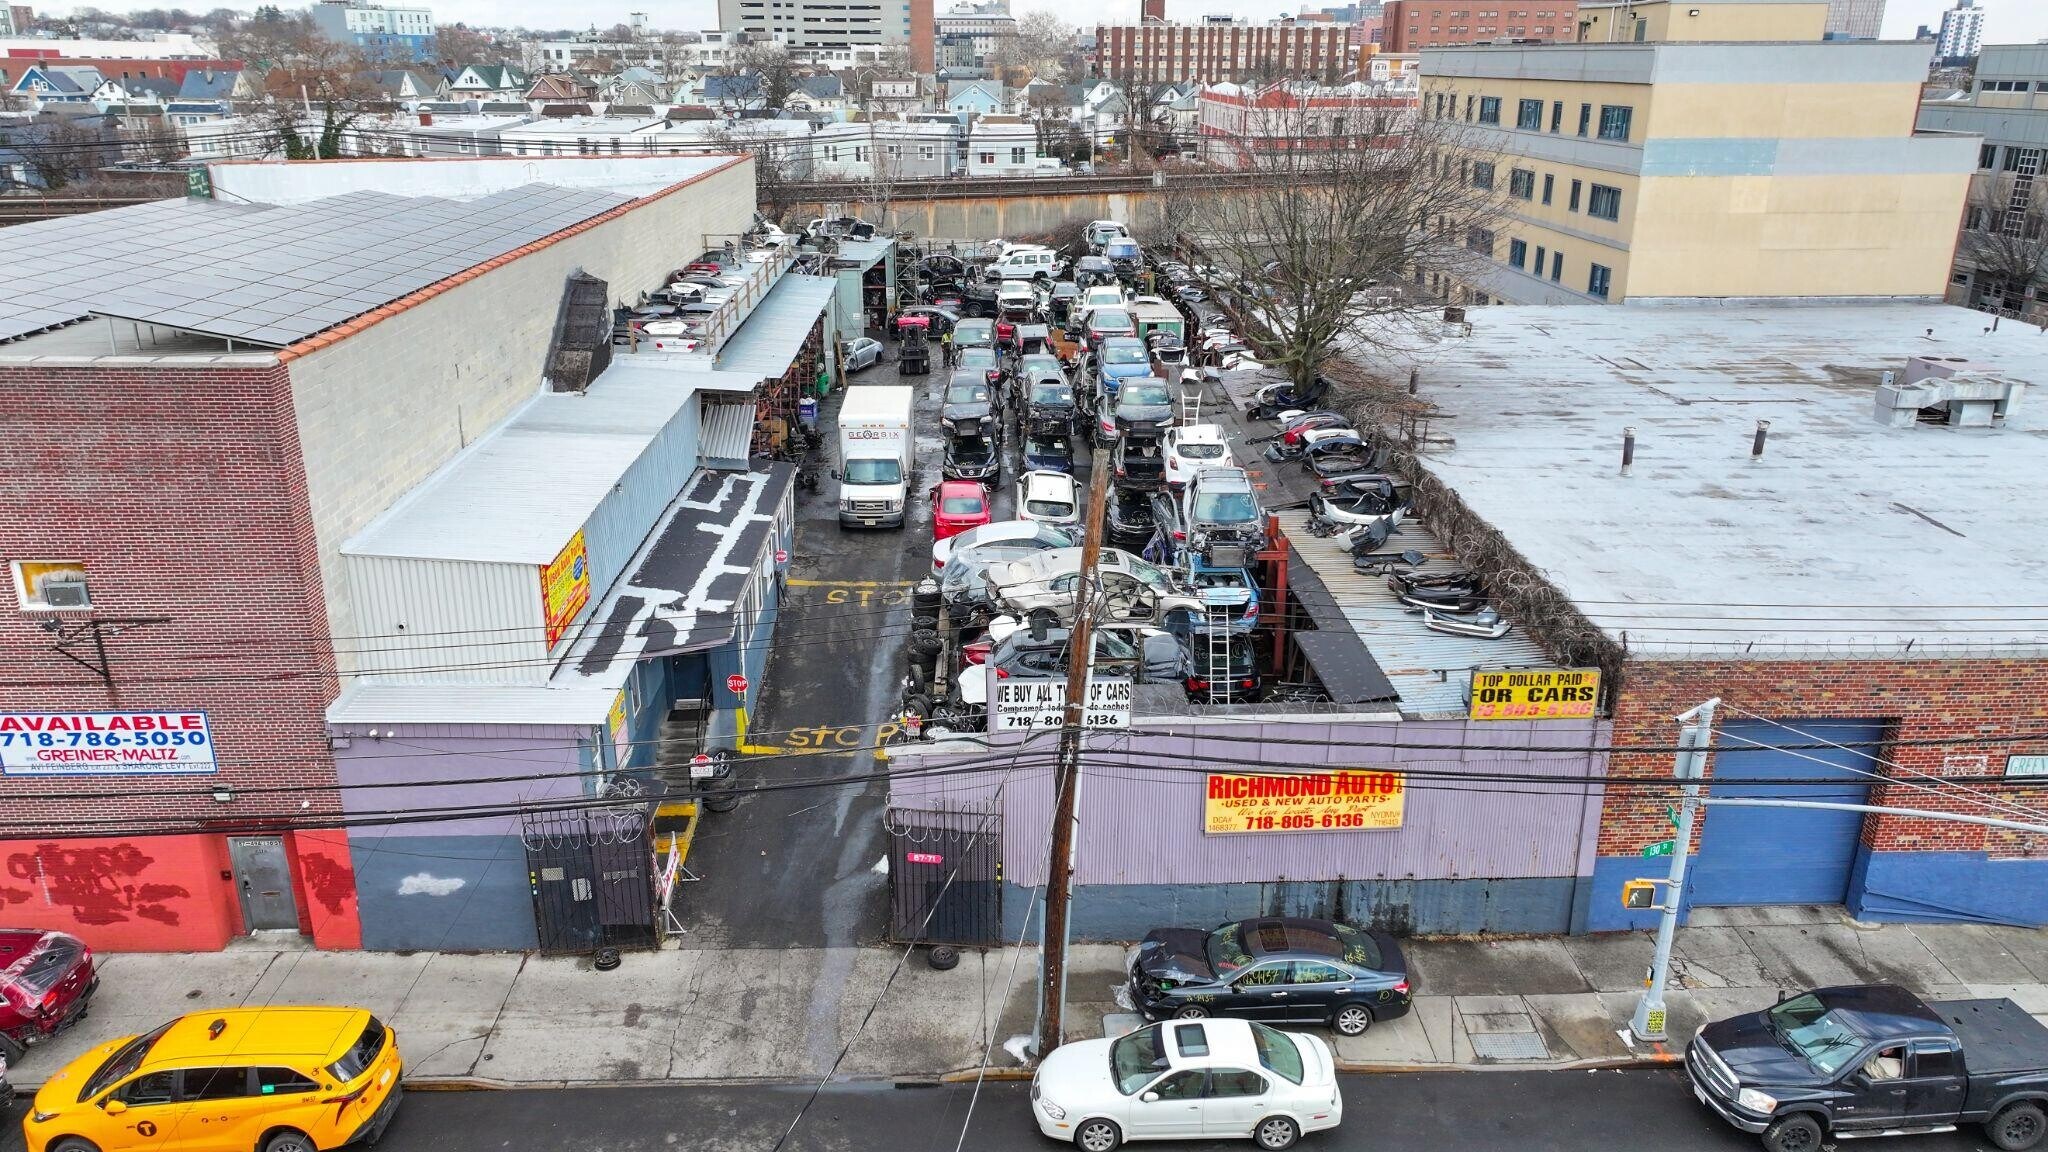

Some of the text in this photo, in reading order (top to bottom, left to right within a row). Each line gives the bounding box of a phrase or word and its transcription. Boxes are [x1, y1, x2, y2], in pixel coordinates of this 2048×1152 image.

[728, 679, 747, 688] STOP
[1482, 675, 1503, 687] TOP
[1509, 674, 1551, 687] DOLLAR
[1557, 673, 1583, 686] PAID
[997, 685, 1009, 702] WE
[1014, 685, 1032, 702] BUY
[1091, 683, 1102, 700] OF
[1106, 683, 1130, 700] CARS
[1527, 686, 1594, 703] CARS
[0, 716, 203, 731] AVAILABLE
[0, 732, 206, 747] 718-786-5050
[37, 749, 178, 762] GREINER-MALTZ
[1209, 772, 1395, 799] RICHMOND AUTO
[1225, 794, 1387, 808] USED & NEW AUTO PARTS
[1245, 812, 1364, 830] 718-805-6136
[1649, 845, 1661, 856] 130
